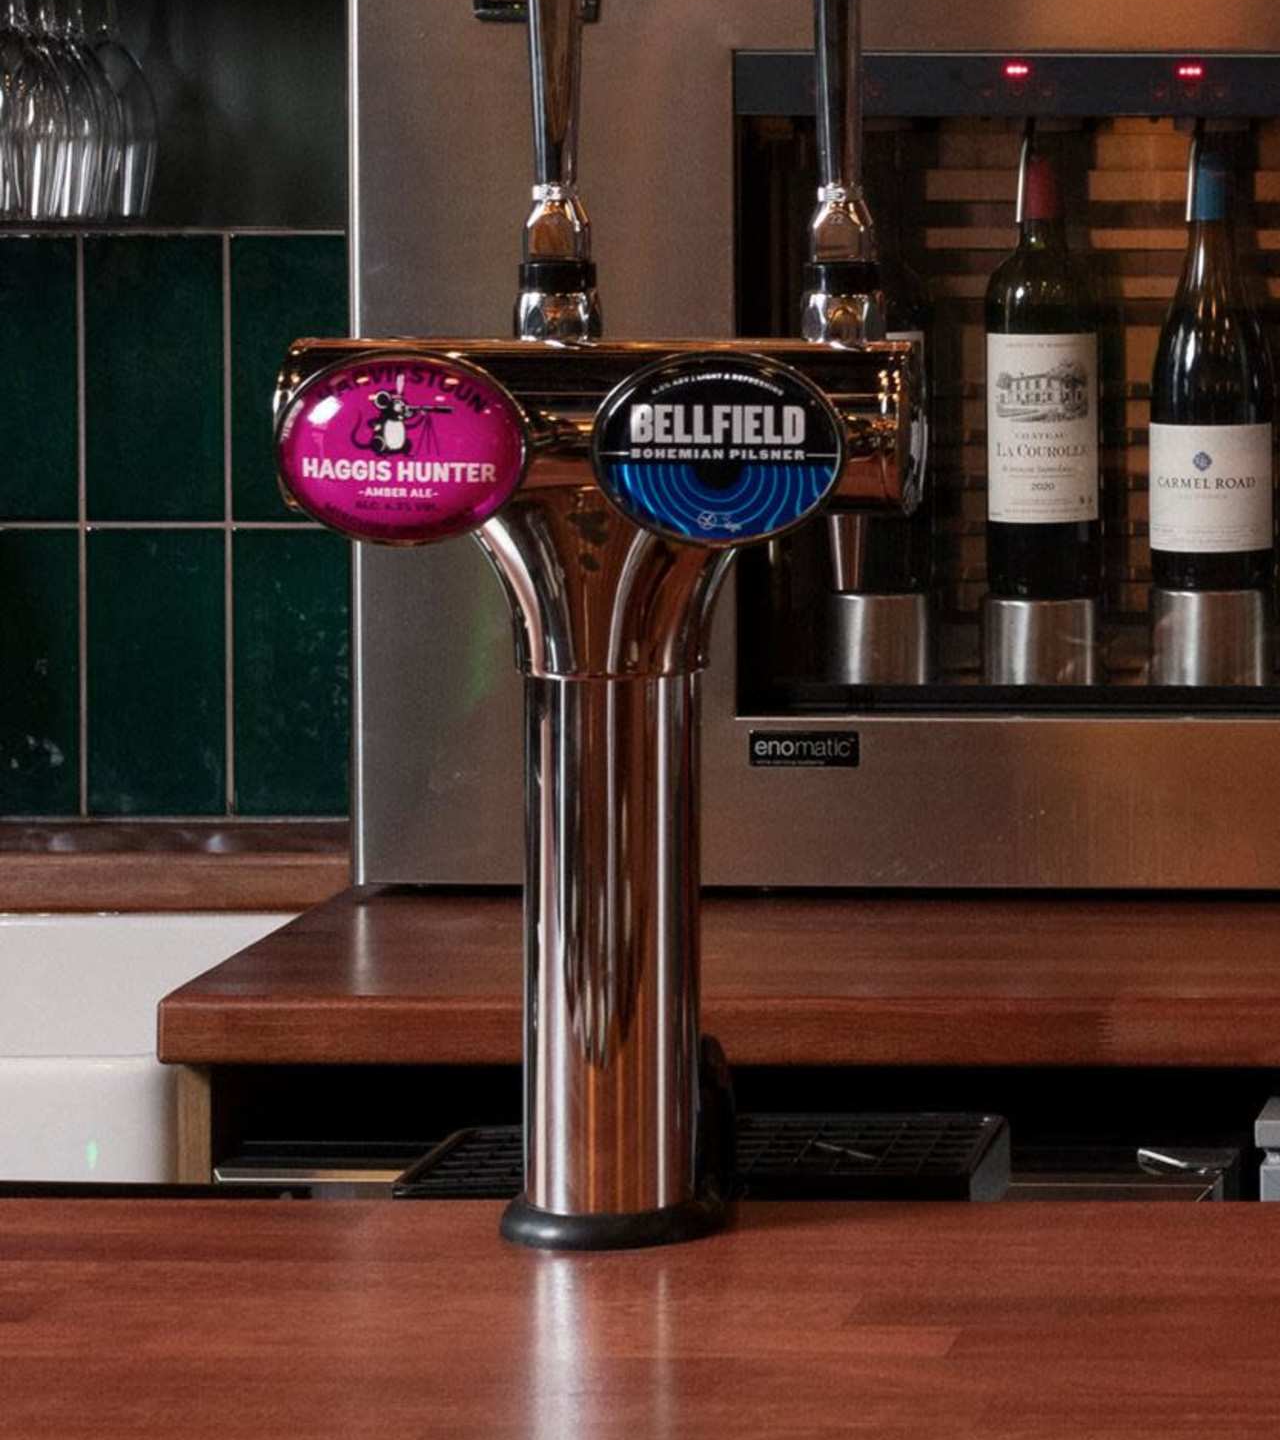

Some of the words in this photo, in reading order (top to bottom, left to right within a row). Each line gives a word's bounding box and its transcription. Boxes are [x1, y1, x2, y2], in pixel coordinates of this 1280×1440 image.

[630, 404, 806, 445] BELLFIELD
[630, 448, 725, 460] BOHEMIAN
[729, 449, 805, 461] PILSNER
[302, 456, 392, 483] HAGGIS
[396, 461, 497, 484] HUNTER
[1157, 476, 1211, 490] CARMEL
[1215, 475, 1256, 489] ROAD
[753, 737, 851, 758] enomatic
